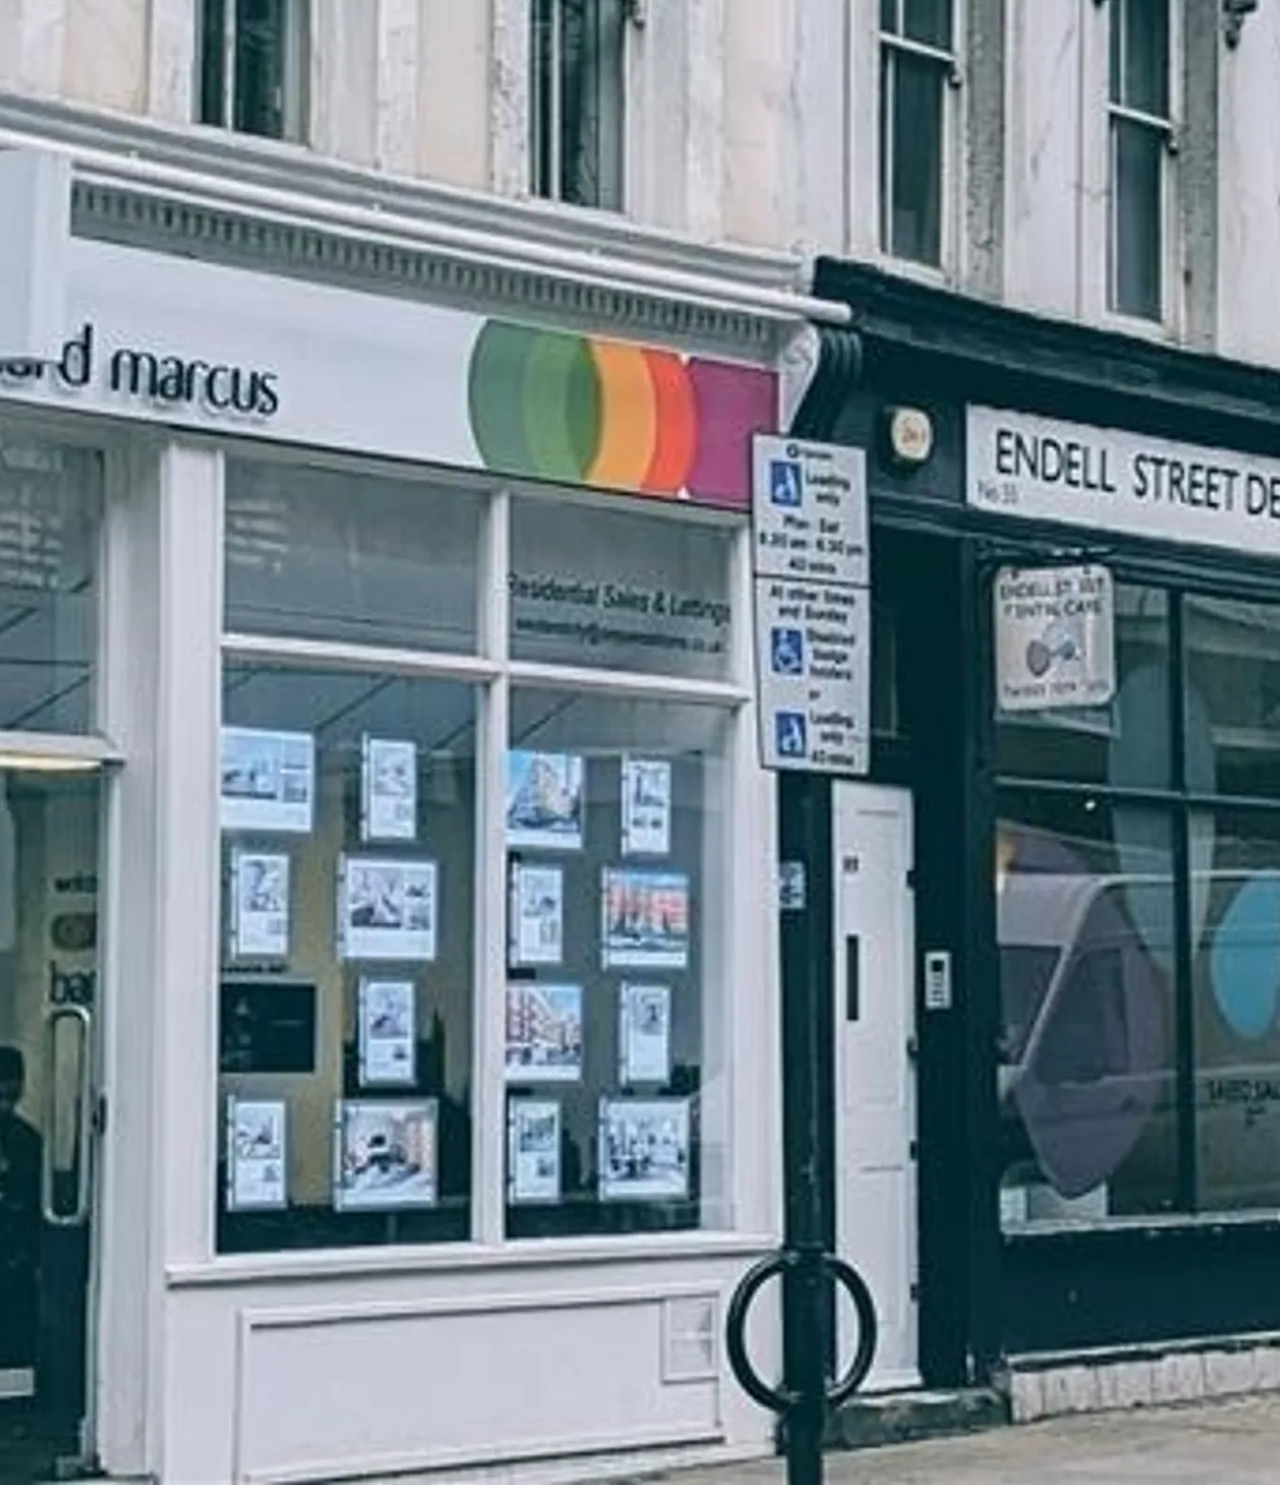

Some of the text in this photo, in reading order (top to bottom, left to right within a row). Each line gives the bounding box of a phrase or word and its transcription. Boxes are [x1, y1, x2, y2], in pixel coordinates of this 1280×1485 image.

[110, 346, 280, 417] marcus
[995, 426, 1117, 493] ENDELL
[1133, 453, 1240, 511] STREET
